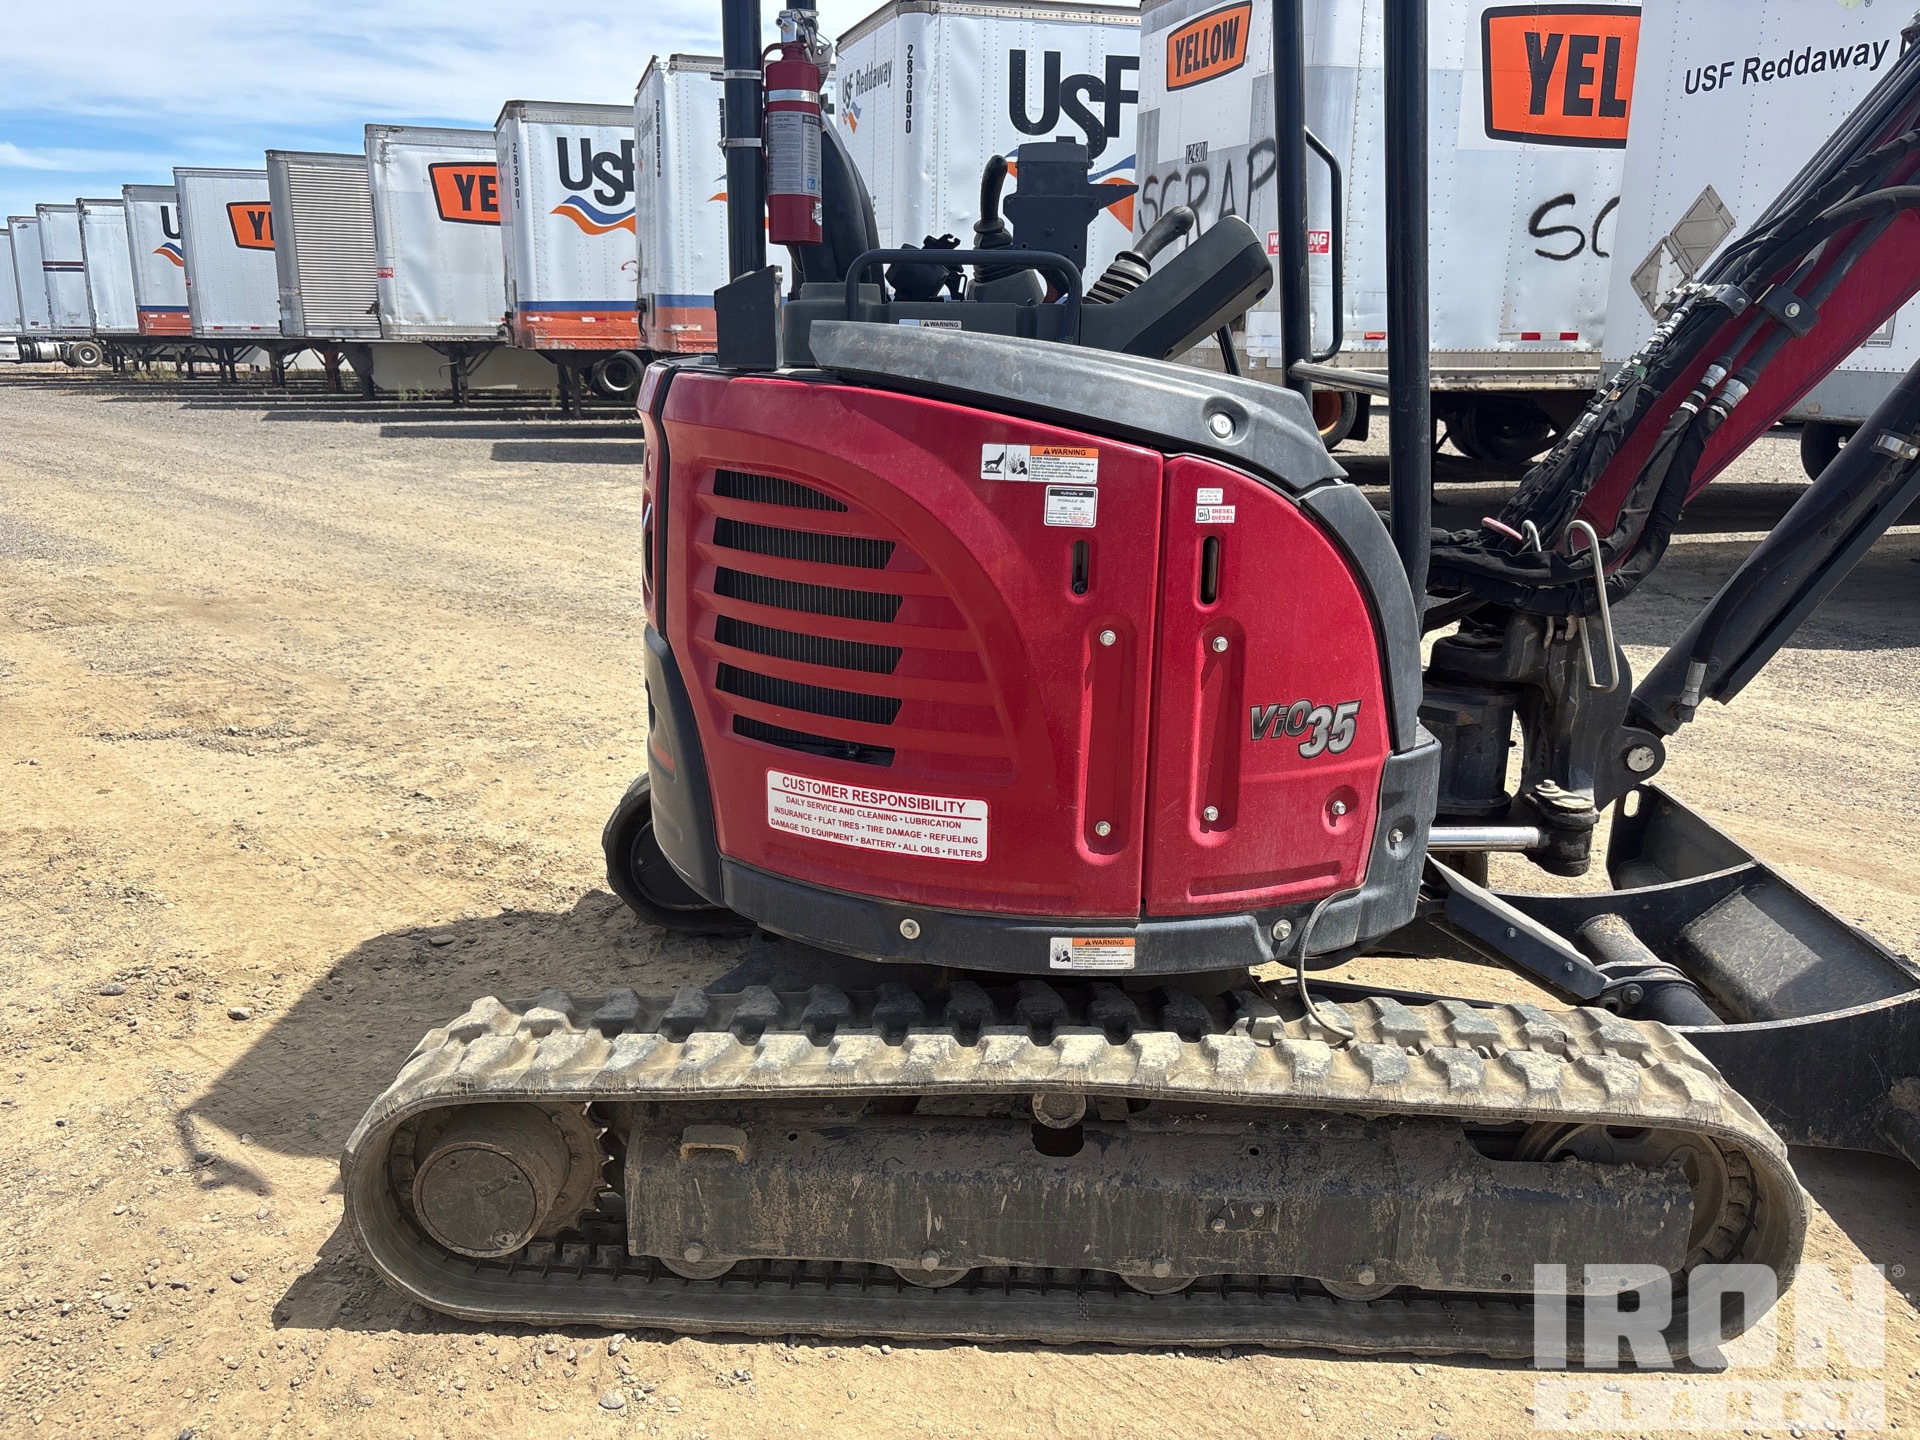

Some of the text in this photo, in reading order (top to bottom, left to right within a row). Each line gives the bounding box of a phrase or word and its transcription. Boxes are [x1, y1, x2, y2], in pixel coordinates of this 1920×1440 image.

[1176, 16, 1240, 77] YELLOW
[1684, 39, 1889, 95] USF Reddaway
[856, 60, 892, 98] Reddaway
[905, 44, 914, 134] 283090
[1524, 32, 1627, 118] YEL
[512, 142, 520, 210] 283901
[1139, 137, 1276, 248] SCRAP
[782, 776, 966, 814] CUSTOMER RESPONSIBILITY
[786, 796, 962, 829] DAILY SERVICE AND CLEANING LUBRICATION
[771, 818, 982, 859] DAMAGE TO EQUIPMENT BATTERY ALL OILS FILTERS
[774, 806, 978, 845] INSURANCE FLAT TIRES TIRE DAMAGE REFUELING
